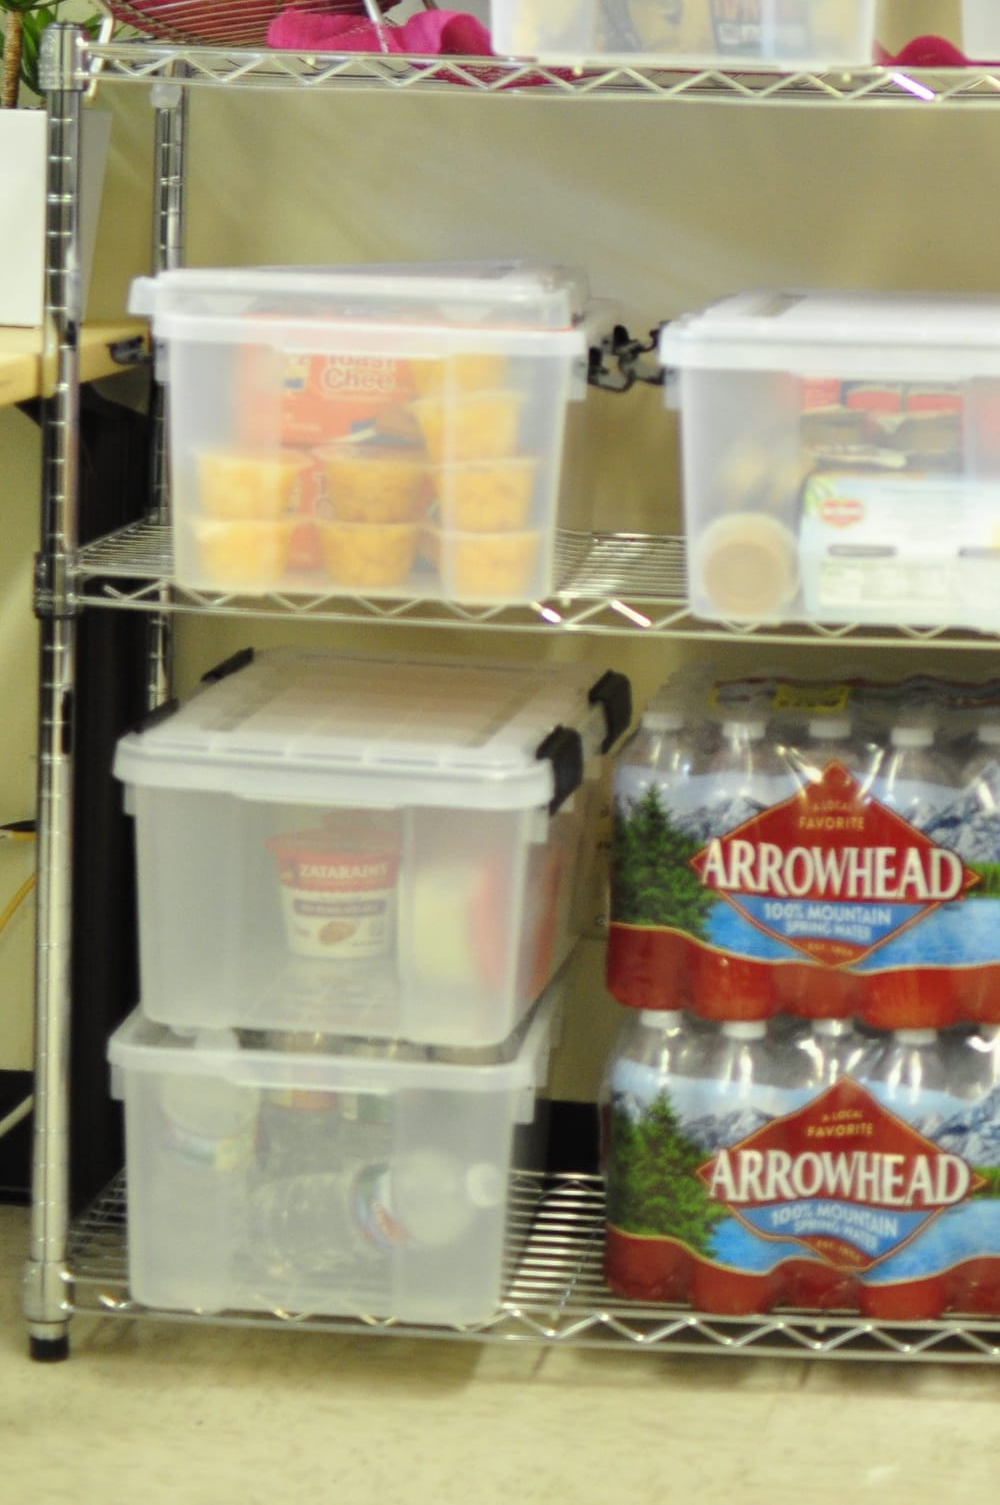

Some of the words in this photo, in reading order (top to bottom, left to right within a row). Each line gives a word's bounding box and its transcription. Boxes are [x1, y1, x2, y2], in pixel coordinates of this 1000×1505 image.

[799, 816, 865, 830] FAVORITE
[702, 837, 963, 900] ARROWHEAD
[807, 904, 892, 925] MOUNTAIN
[785, 920, 832, 935] SPRING
[806, 1123, 873, 1137] FAVORITE
[709, 1149, 970, 1206] ARROWHEAD
[816, 1203, 898, 1238] MOUNTAIN
